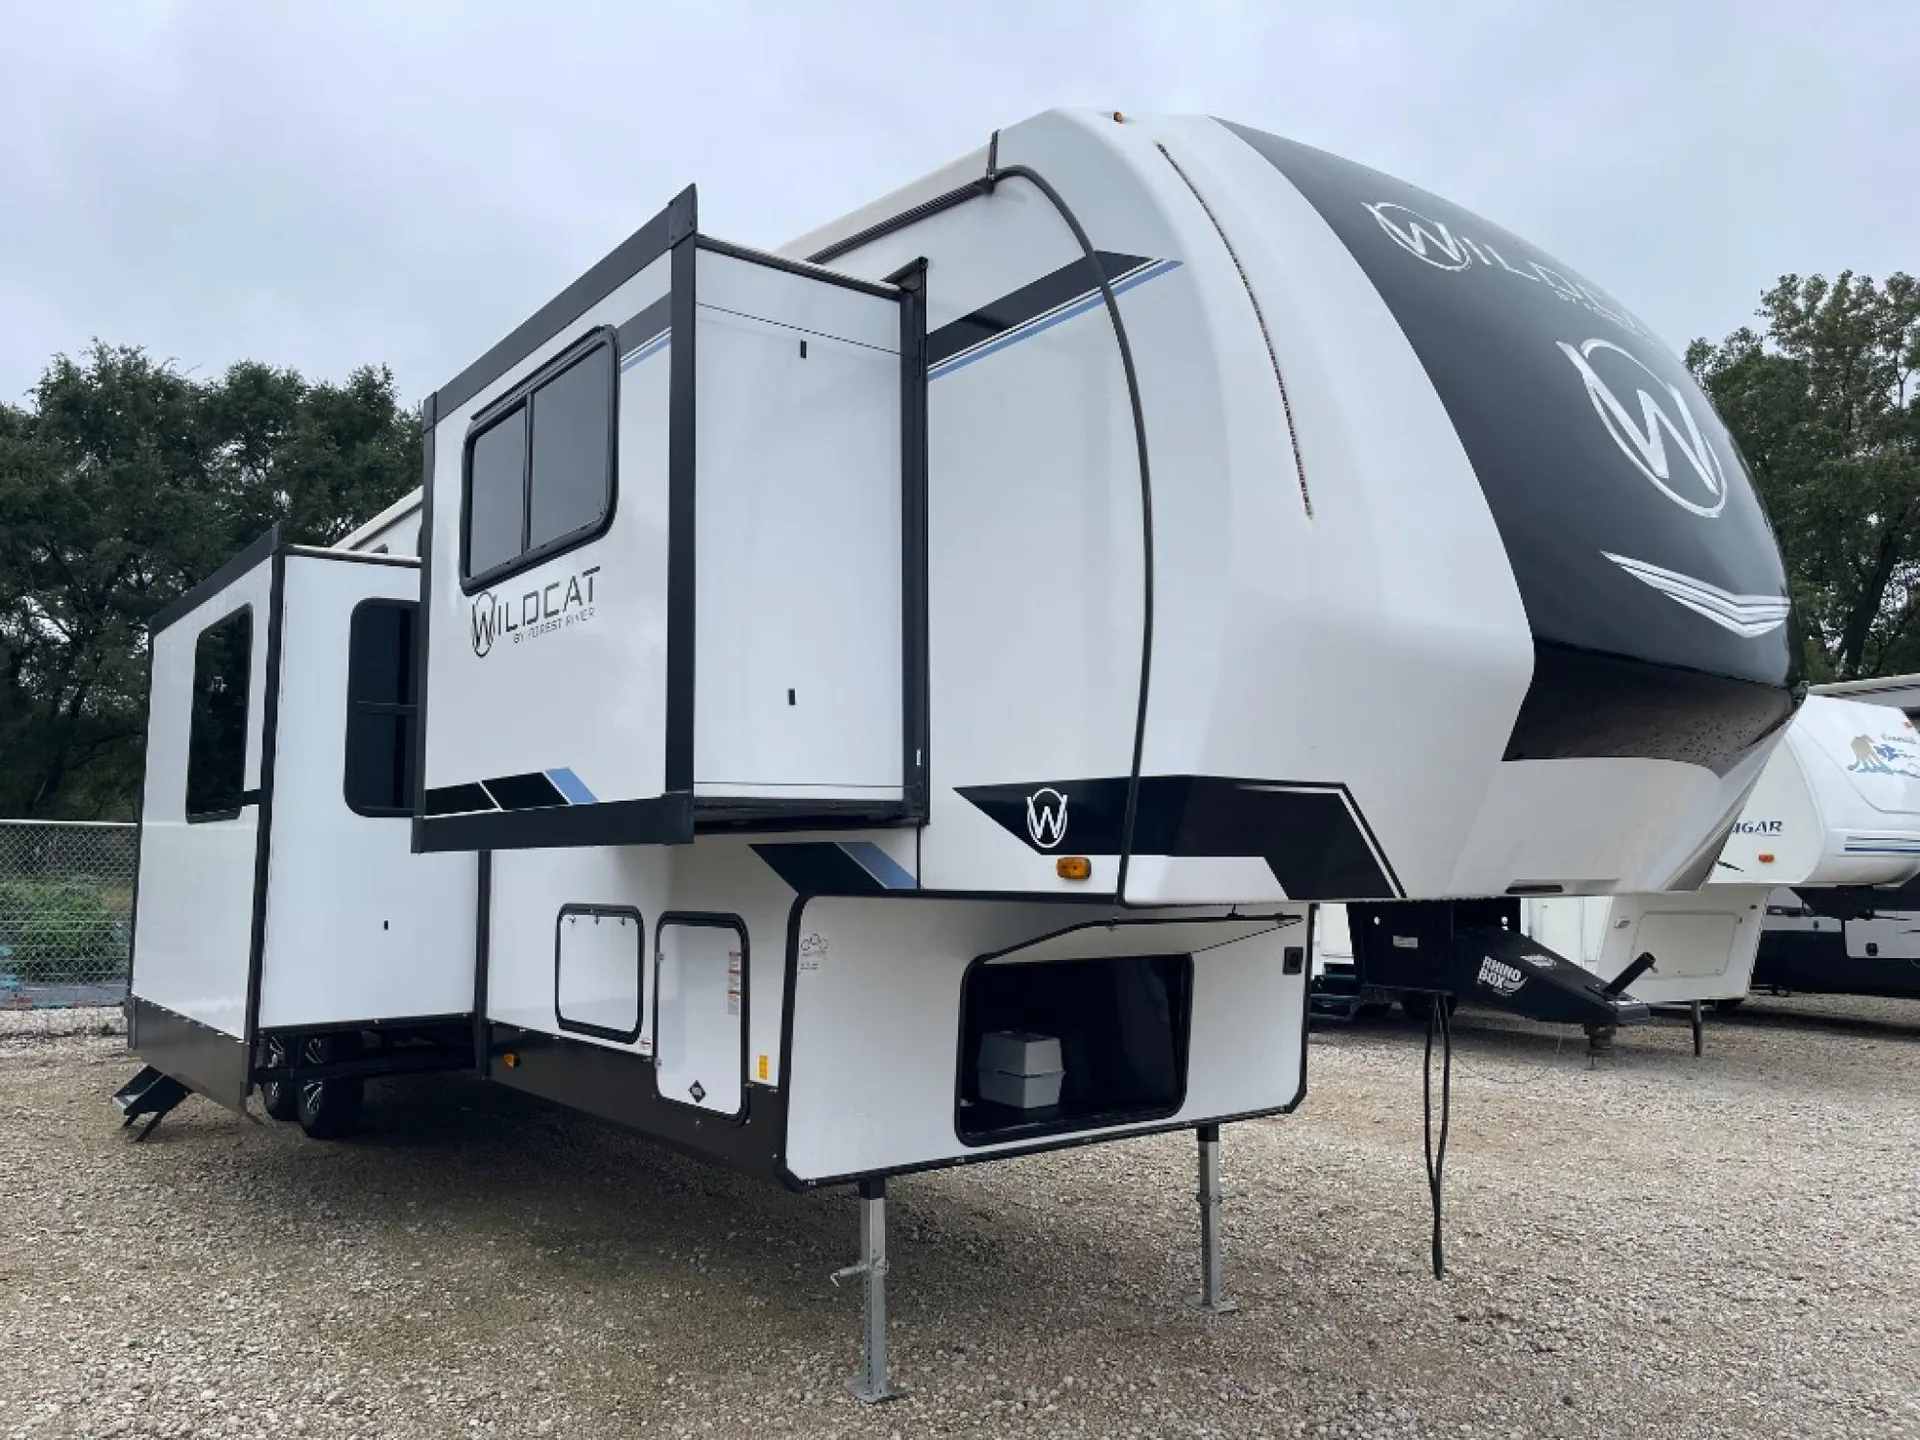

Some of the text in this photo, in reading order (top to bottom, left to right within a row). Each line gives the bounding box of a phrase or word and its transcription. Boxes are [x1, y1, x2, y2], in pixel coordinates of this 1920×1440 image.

[471, 565, 601, 658] WILDCAT
[513, 630, 525, 644] BY
[1026, 787, 1068, 848] W
[1479, 967, 1505, 989] BOX
[1482, 955, 1522, 982] RHINO
